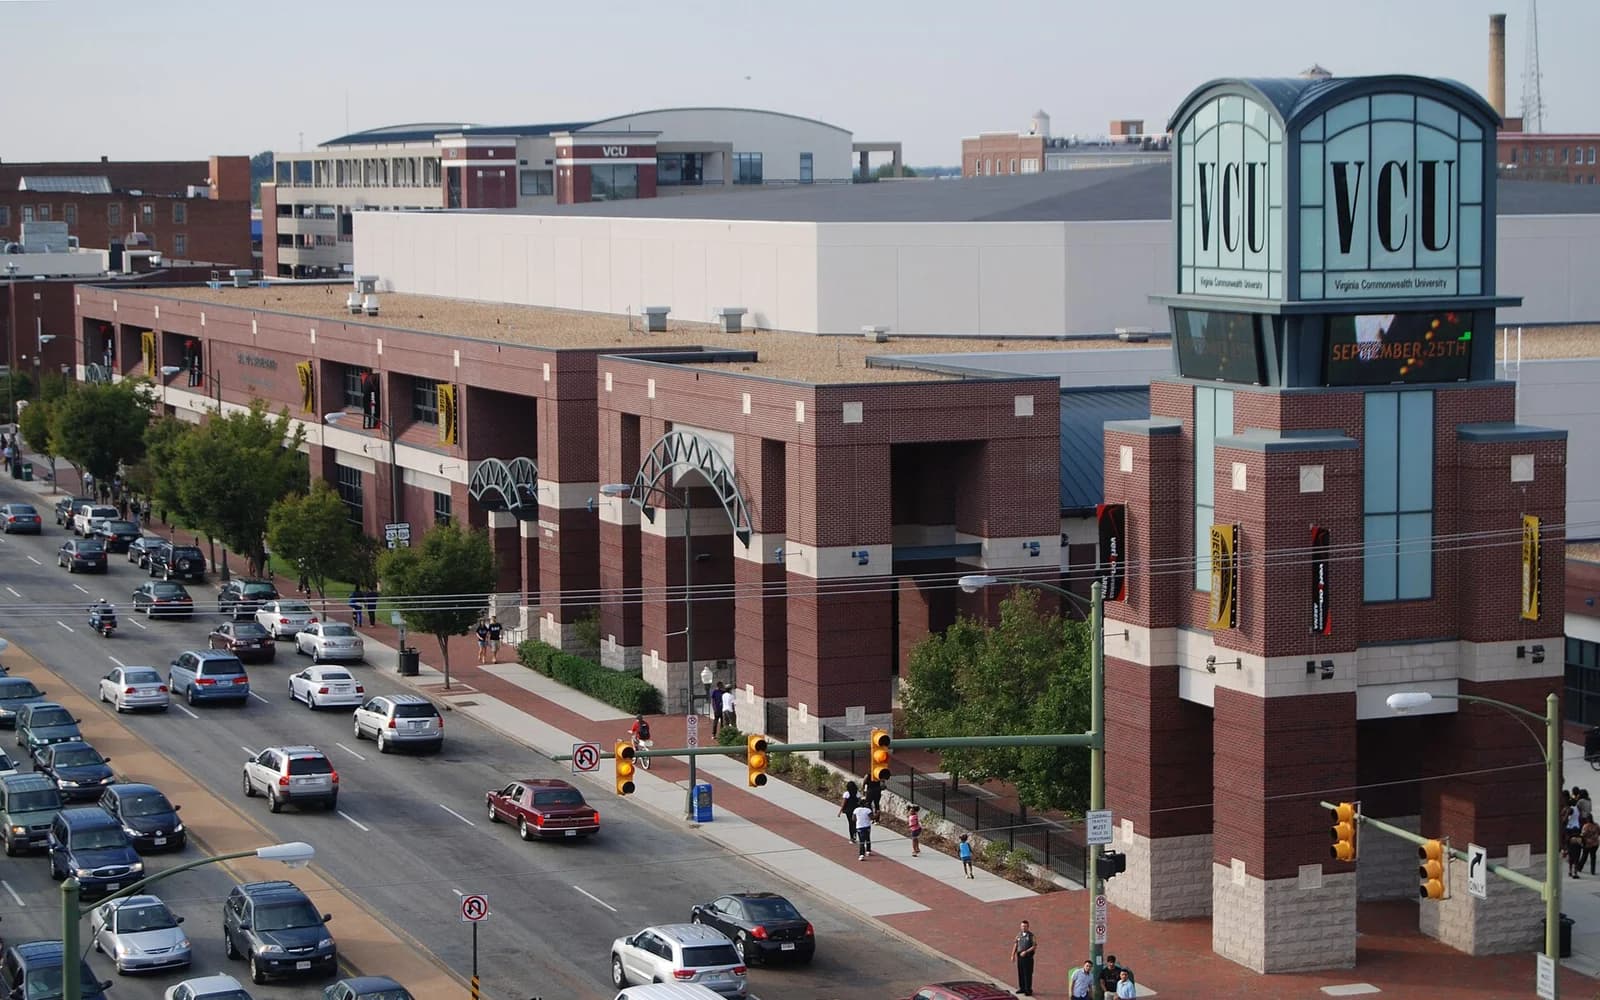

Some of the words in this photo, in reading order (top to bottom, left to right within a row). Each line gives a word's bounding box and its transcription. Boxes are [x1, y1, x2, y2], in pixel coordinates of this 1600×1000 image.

[602, 146, 628, 157] VCU
[1198, 162, 1267, 253] VCU
[1330, 160, 1456, 254] VCU
[1334, 280, 1359, 292] Virginia
[1361, 279, 1412, 289] Commonwealth
[1414, 277, 1448, 289] University
[1332, 341, 1421, 360] SEPMBER
[1211, 529, 1221, 573] SIEGEL
[1470, 880, 1485, 894] ONLY
